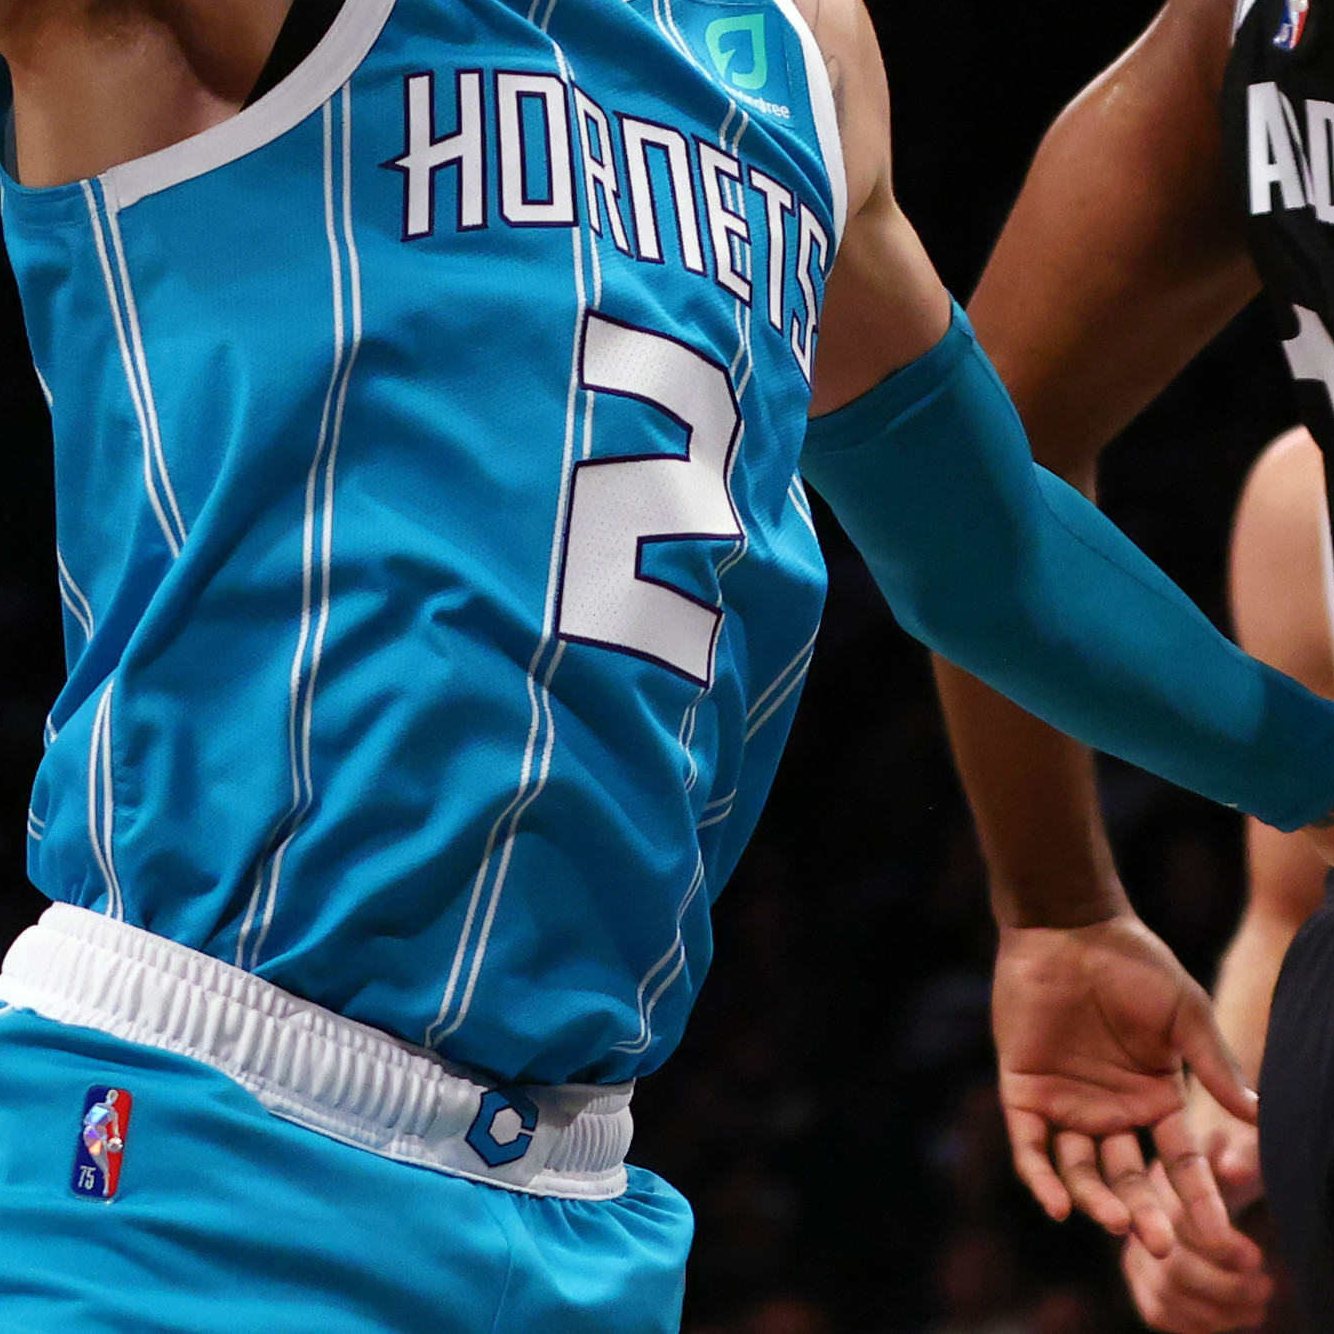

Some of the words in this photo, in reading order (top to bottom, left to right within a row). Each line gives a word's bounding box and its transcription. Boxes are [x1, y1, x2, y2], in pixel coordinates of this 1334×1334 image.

[378, 68, 829, 391] HORNETS
[555, 307, 746, 689] 2
[77, 1164, 97, 1191] 75
